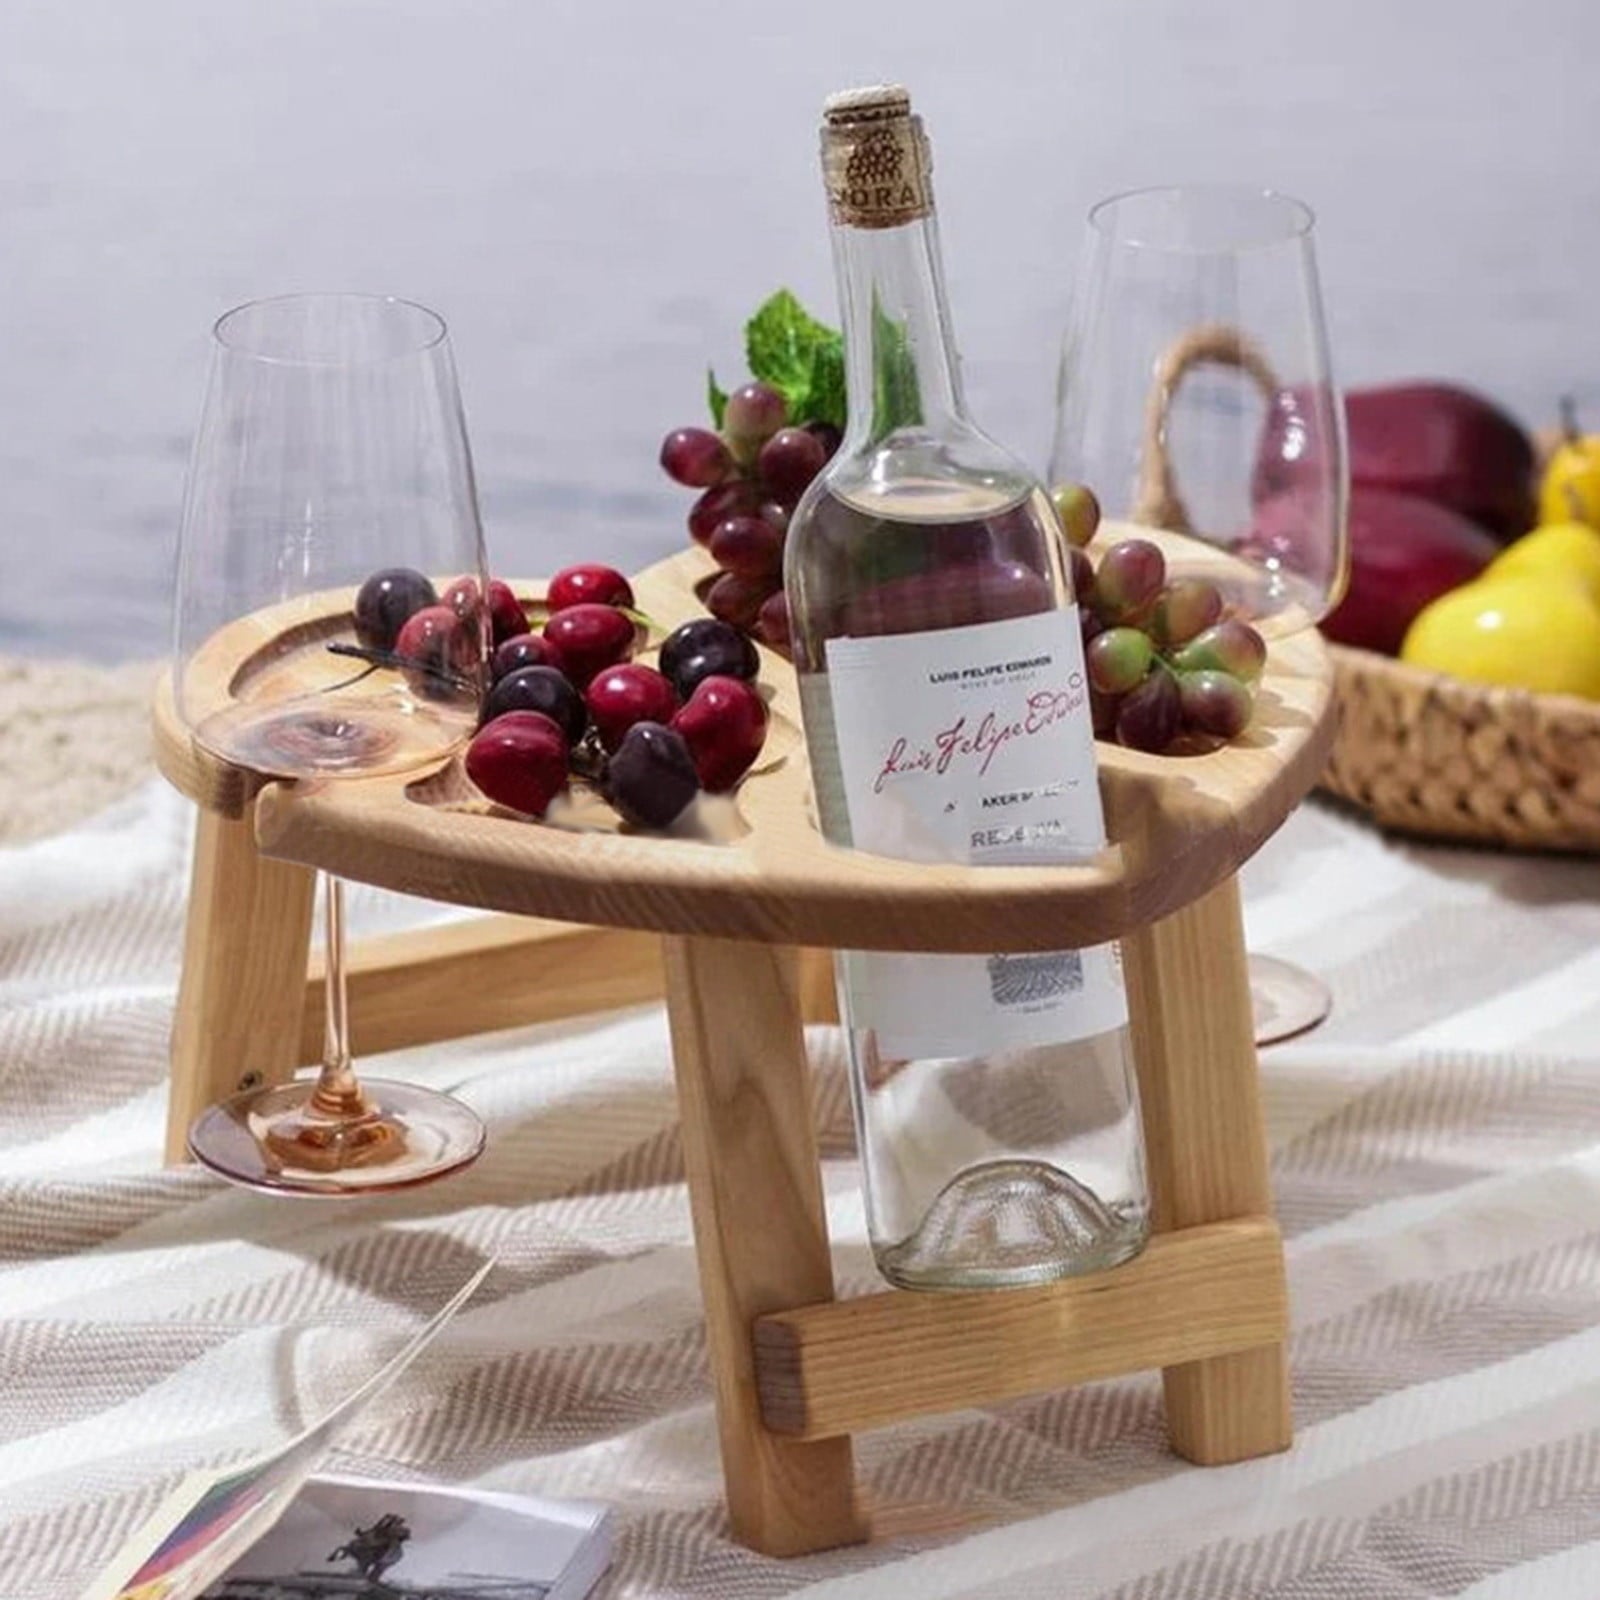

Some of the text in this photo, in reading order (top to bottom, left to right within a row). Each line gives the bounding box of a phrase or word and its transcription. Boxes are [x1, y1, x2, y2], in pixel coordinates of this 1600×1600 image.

[929, 671, 960, 685] LUIS
[961, 664, 1004, 679] FELIPE
[873, 737, 934, 794] Luis
[935, 711, 1022, 777] Felipe
